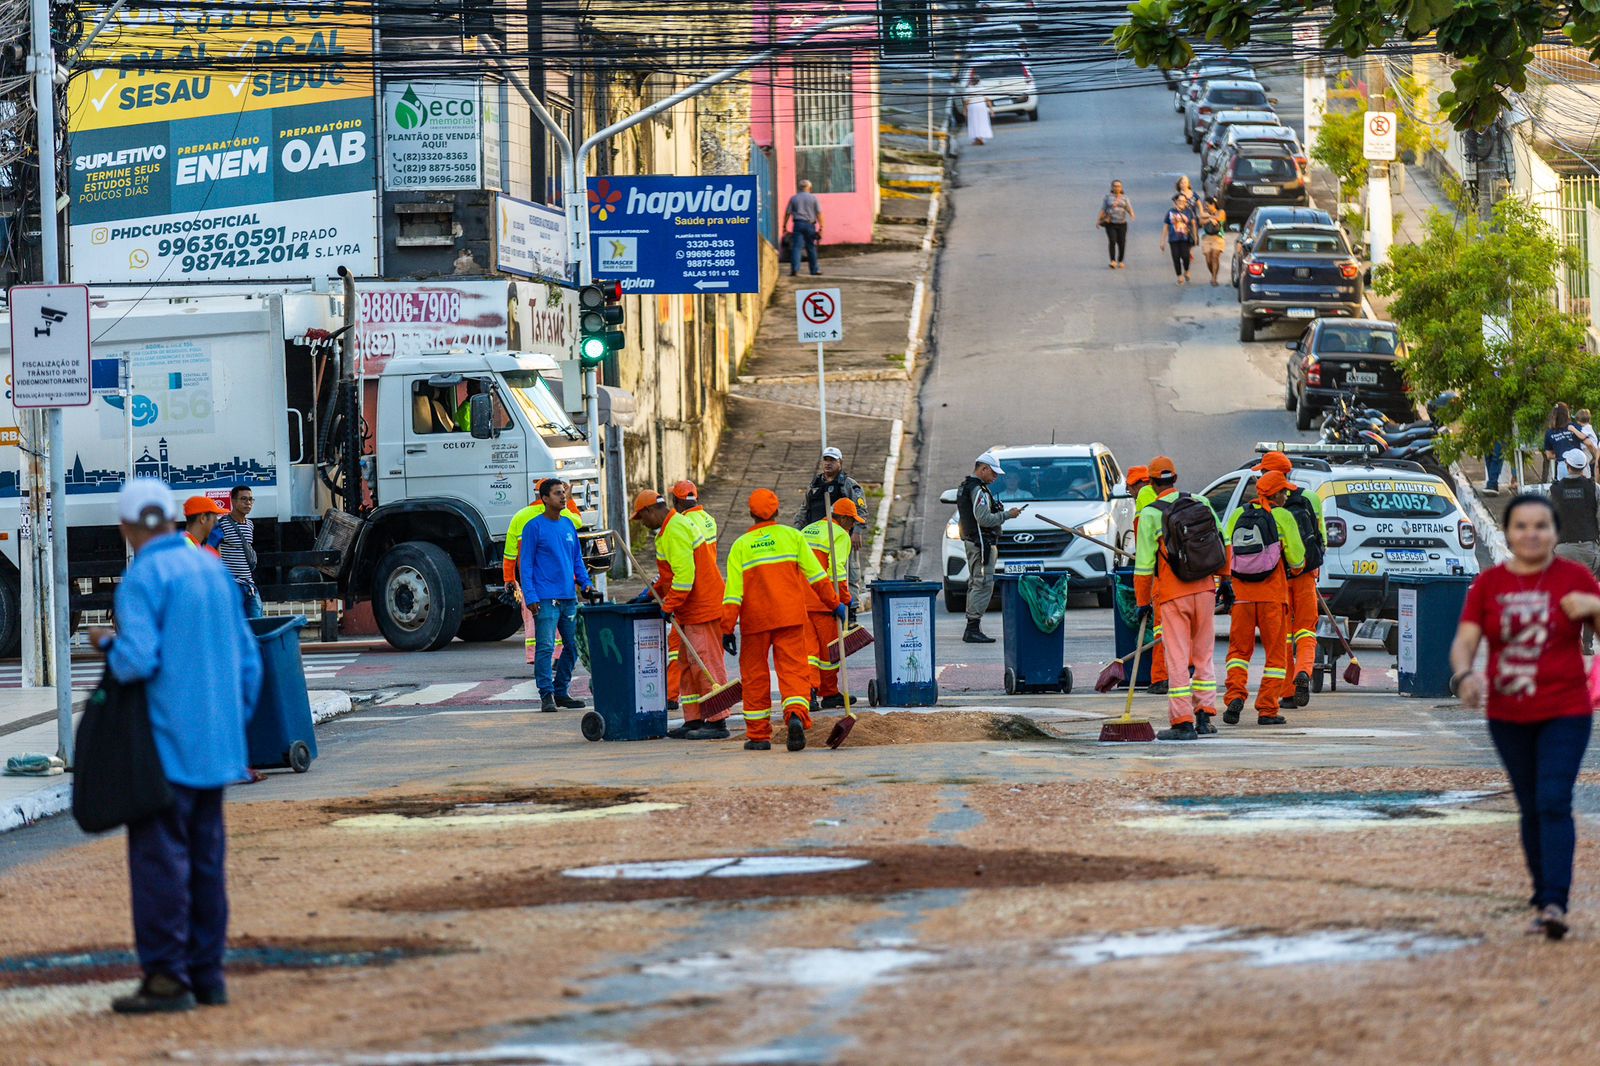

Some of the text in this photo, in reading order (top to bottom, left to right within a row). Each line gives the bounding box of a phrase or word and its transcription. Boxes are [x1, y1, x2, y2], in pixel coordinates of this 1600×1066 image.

[251, 62, 345, 97] SEDUC
[119, 76, 211, 110] SESAU
[430, 100, 474, 116] eco
[279, 119, 363, 138] PREPARATÓRIO
[430, 117, 474, 125] memorial
[387, 132, 430, 141] PLANTÃO
[446, 132, 481, 141] VENDAS
[178, 136, 260, 155] PREPARATÓRIO
[281, 130, 366, 173] OAB
[421, 141, 448, 149] AQUI!
[75, 144, 166, 171] SUPLETIVO
[403, 152, 468, 161] (82)3320-8363
[86, 163, 161, 182] TERMINE SEUS
[176, 146, 269, 185] ENEM
[429, 163, 477, 172] 8875-5050
[84, 175, 150, 192] ESTUDOS EM
[429, 175, 477, 183] 9696-2686
[79, 185, 149, 203] POUCOS DIAS
[626, 184, 752, 220] hapvida
[111, 213, 260, 241] PHDCURSOSOFICIAL
[674, 215, 751, 227] Saúde pra valer
[158, 226, 337, 258] 99636.0591 PRADO
[686, 240, 735, 248] 3320-8363
[182, 242, 361, 273] 98742.2014 S.LYRA
[685, 250, 736, 258] 99696-2686
[686, 259, 735, 268] 98875-5050
[682, 270, 707, 278] SALAS
[361, 292, 460, 324] 98806-7908
[804, 330, 827, 339] INÍCIO
[22, 359, 70, 368] FISCALIZAÇÃO
[17, 377, 88, 386] VIDEOMONITORAMENTO
[1347, 482, 1437, 494] POLÍCIA MILITAR
[1368, 493, 1431, 511] 32-0052
[1376, 523, 1444, 533] CPC BPTRAN
[751, 540, 775, 549] MACEIÓ
[1352, 560, 1378, 575] 190
